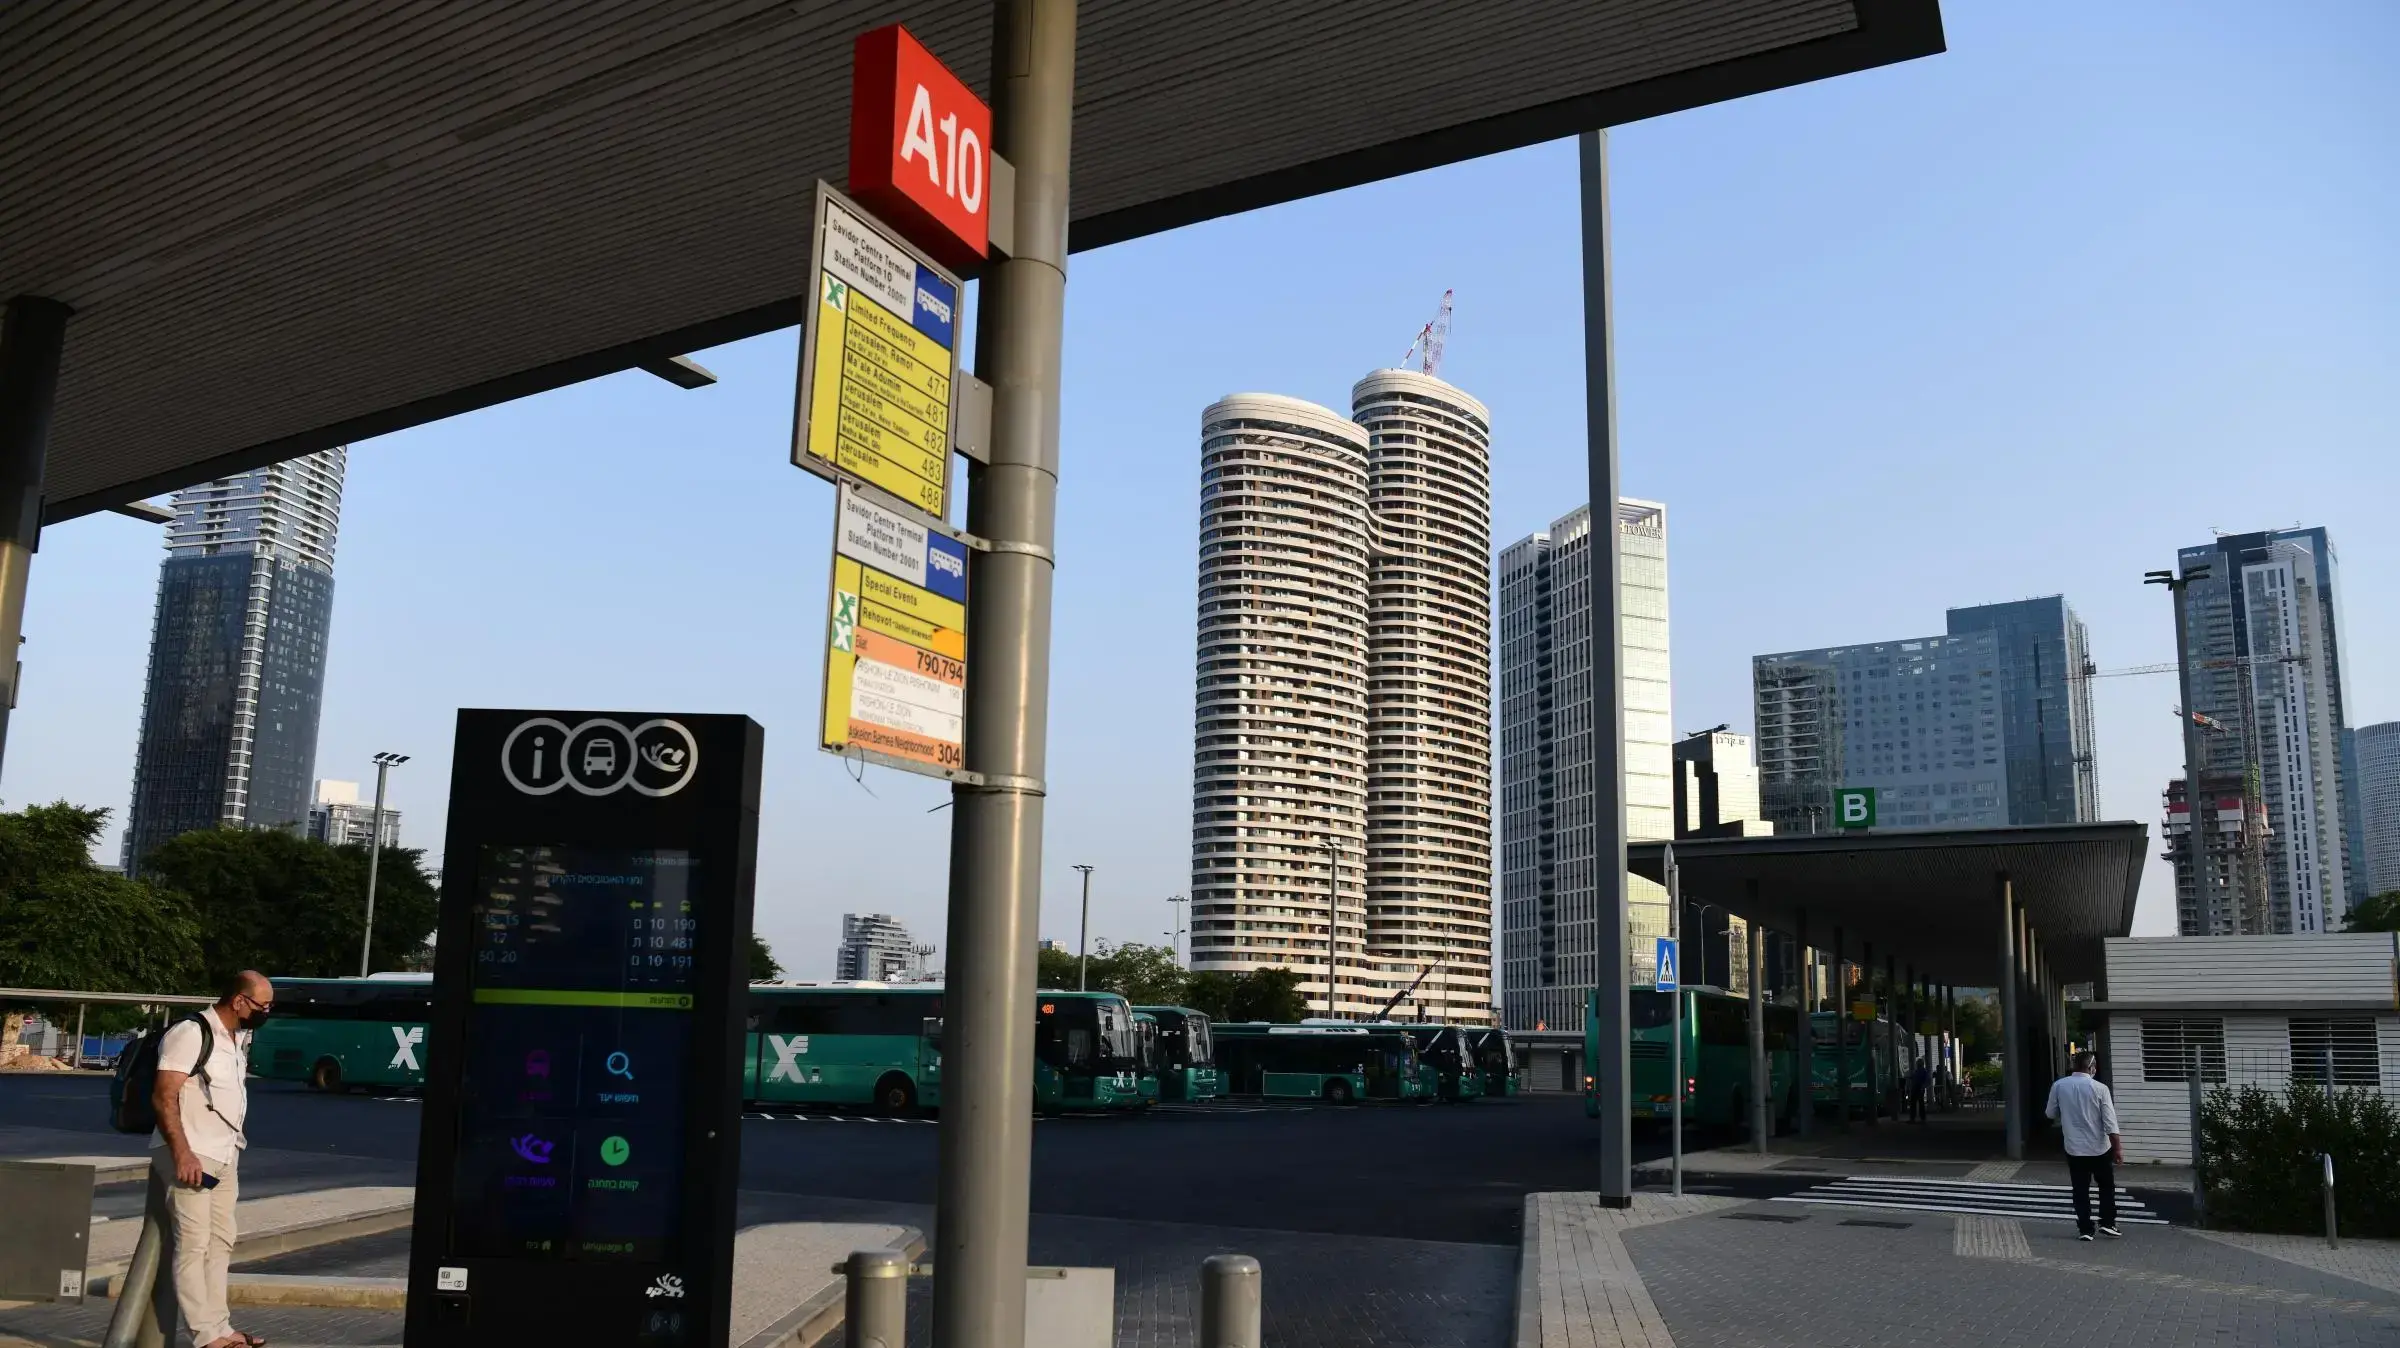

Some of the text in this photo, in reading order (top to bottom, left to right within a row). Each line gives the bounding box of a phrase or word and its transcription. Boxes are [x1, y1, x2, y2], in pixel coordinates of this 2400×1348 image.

[900, 83, 982, 214] A10
[832, 219, 911, 282] Savidor Centre Terminal
[834, 250, 858, 273] Station
[860, 267, 885, 292] Number
[854, 248, 893, 282] Platform 10
[850, 298, 916, 352] Limited Frequency
[890, 348, 913, 371] Ramot
[927, 373, 945, 400] 471
[845, 381, 942, 453] Jerusalem 482
[873, 367, 901, 393] Adumim
[925, 400, 944, 427] 481
[843, 410, 941, 482] Jerusalem 483
[841, 440, 939, 509] Jerusalem 488
[846, 497, 923, 545] Savidor Centre Terminal
[866, 522, 902, 549] Platform 10
[847, 529, 918, 572] Station Number 20001
[864, 575, 917, 607] Special Events
[916, 650, 963, 683] 790,794
[937, 744, 961, 767] 304
[1842, 794, 1869, 821] B
[649, 936, 693, 949] 10 481
[650, 918, 696, 931] 10 190
[648, 955, 692, 967] 10 191
